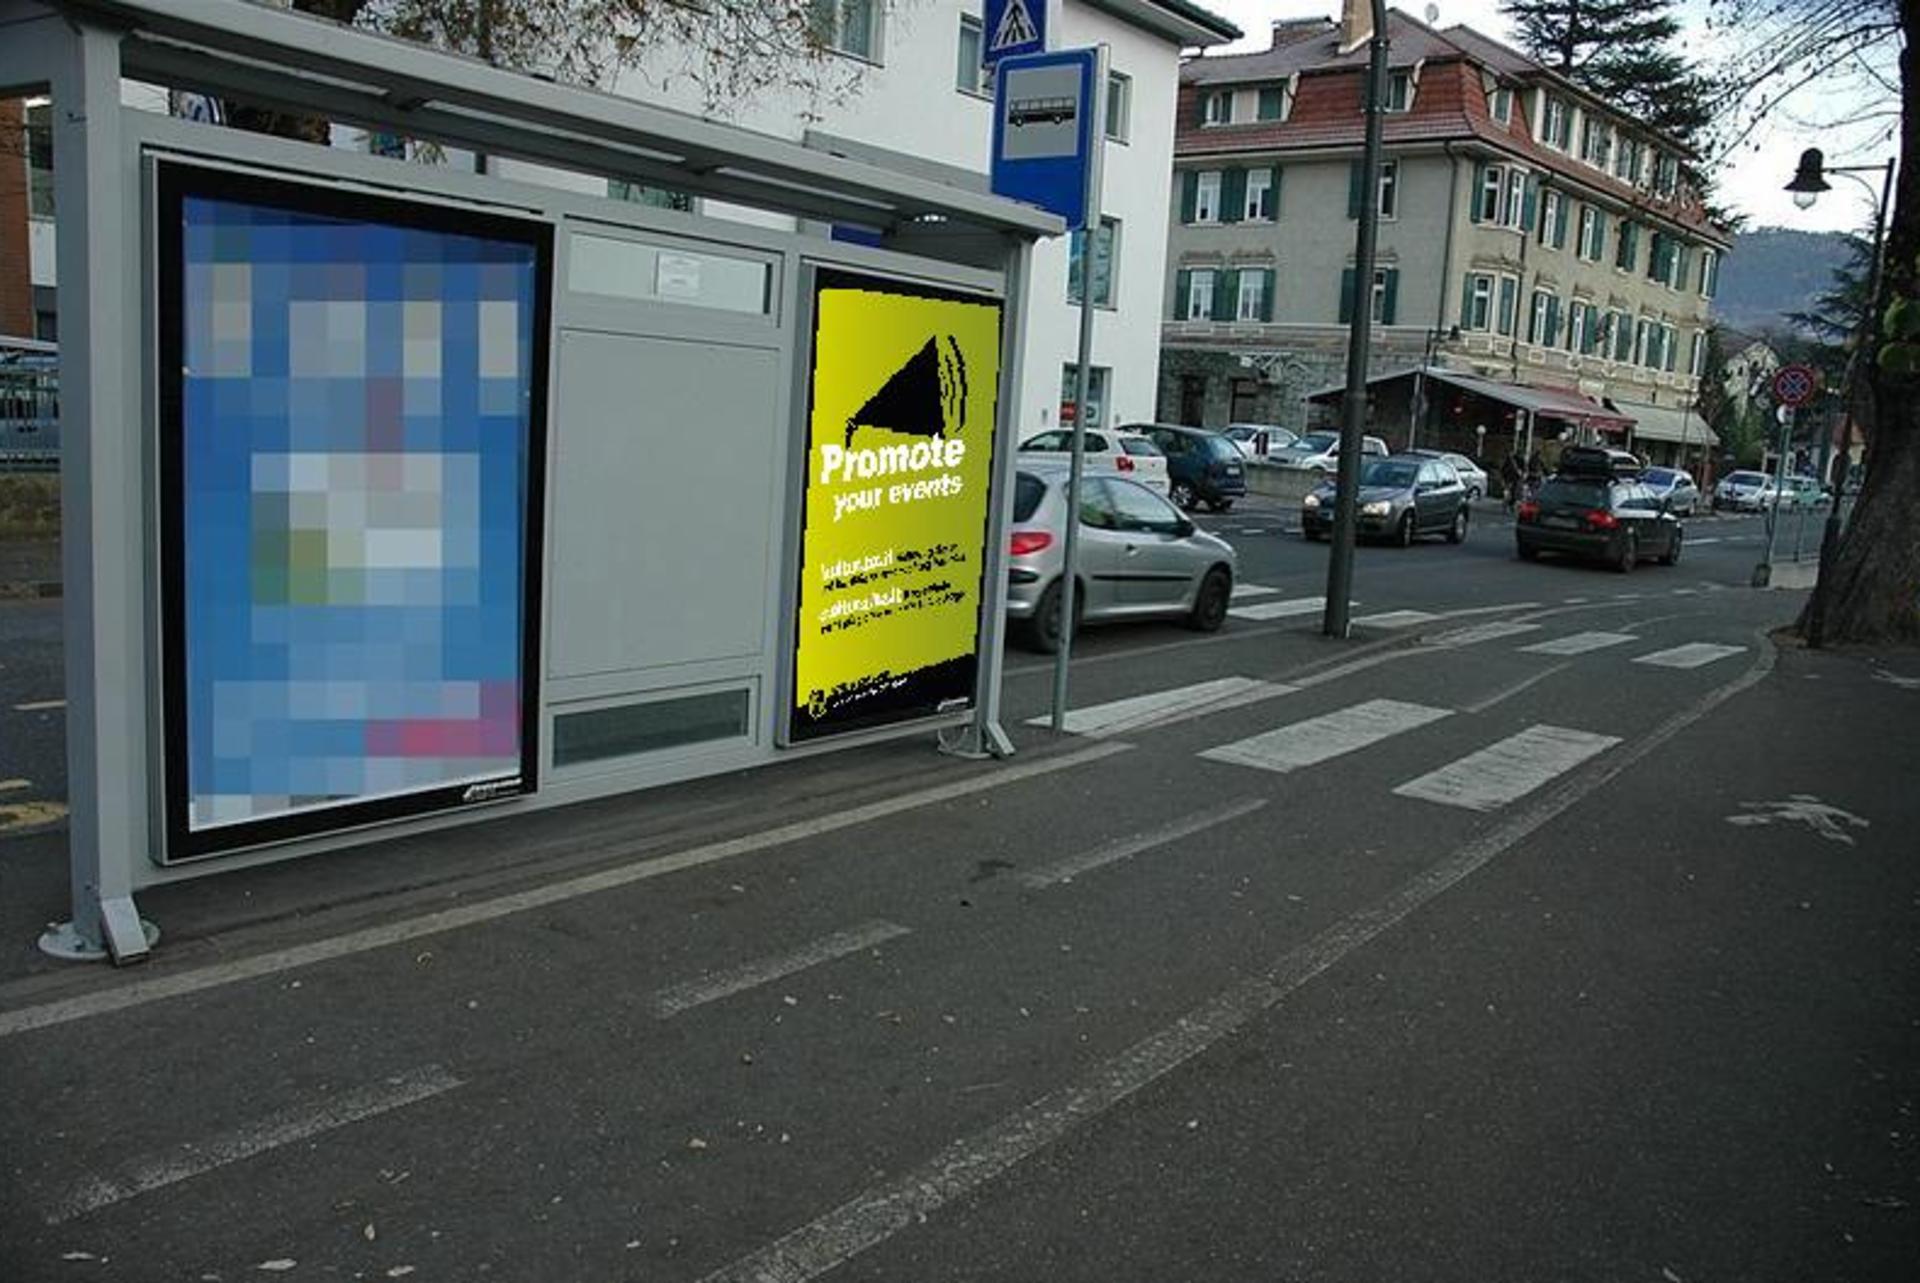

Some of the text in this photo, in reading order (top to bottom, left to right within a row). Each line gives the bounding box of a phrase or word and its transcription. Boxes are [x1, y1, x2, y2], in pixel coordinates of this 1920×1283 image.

[820, 432, 966, 485] Promote
[833, 473, 964, 523] your events
